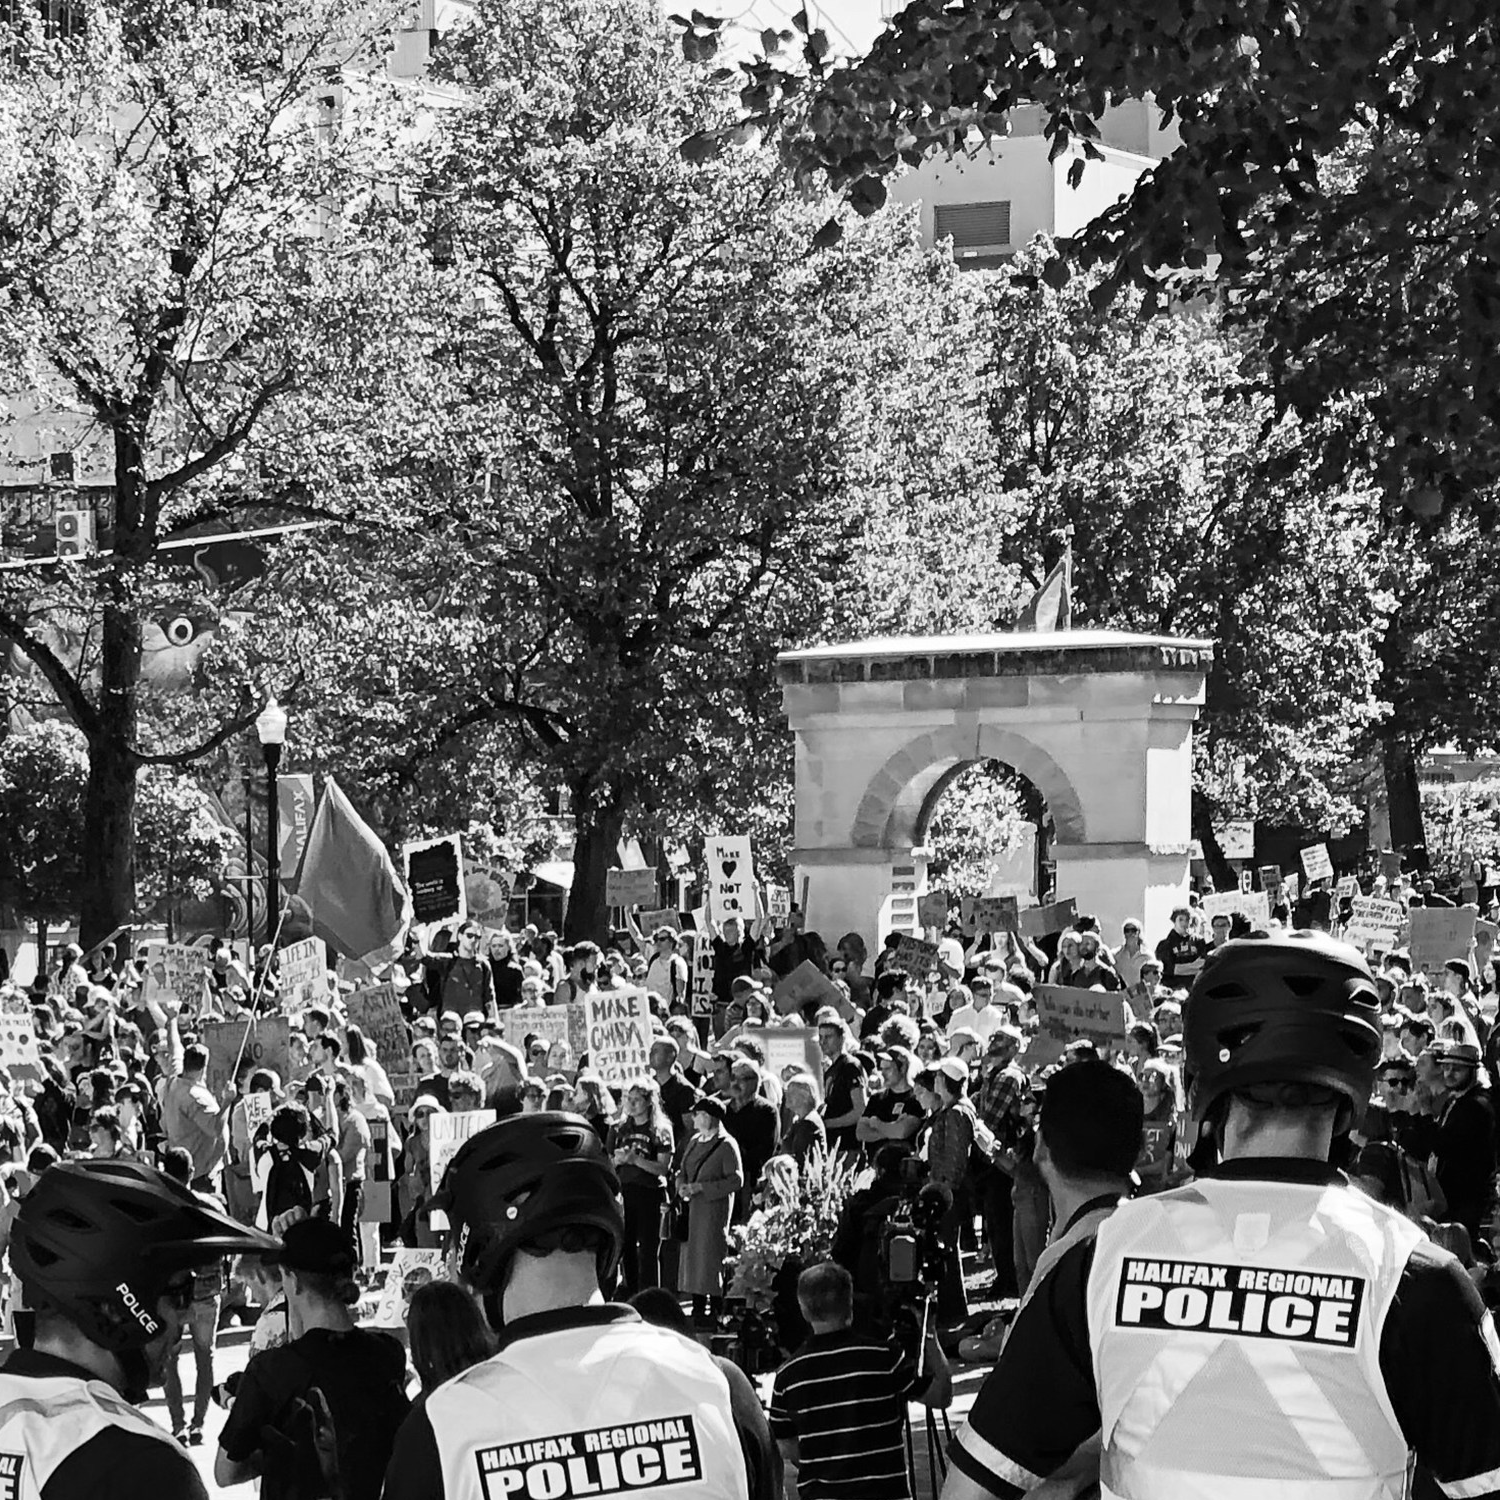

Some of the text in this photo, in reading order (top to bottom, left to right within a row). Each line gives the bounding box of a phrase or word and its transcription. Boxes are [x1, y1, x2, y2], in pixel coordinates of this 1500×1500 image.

[591, 996, 640, 1022] MAKE
[1127, 1261, 1356, 1301] HALIFAX REGIONAL
[116, 1283, 159, 1334] POLICE
[1121, 1283, 1353, 1342] POLICE
[482, 1419, 690, 1471] HALIFAX REGIONAL
